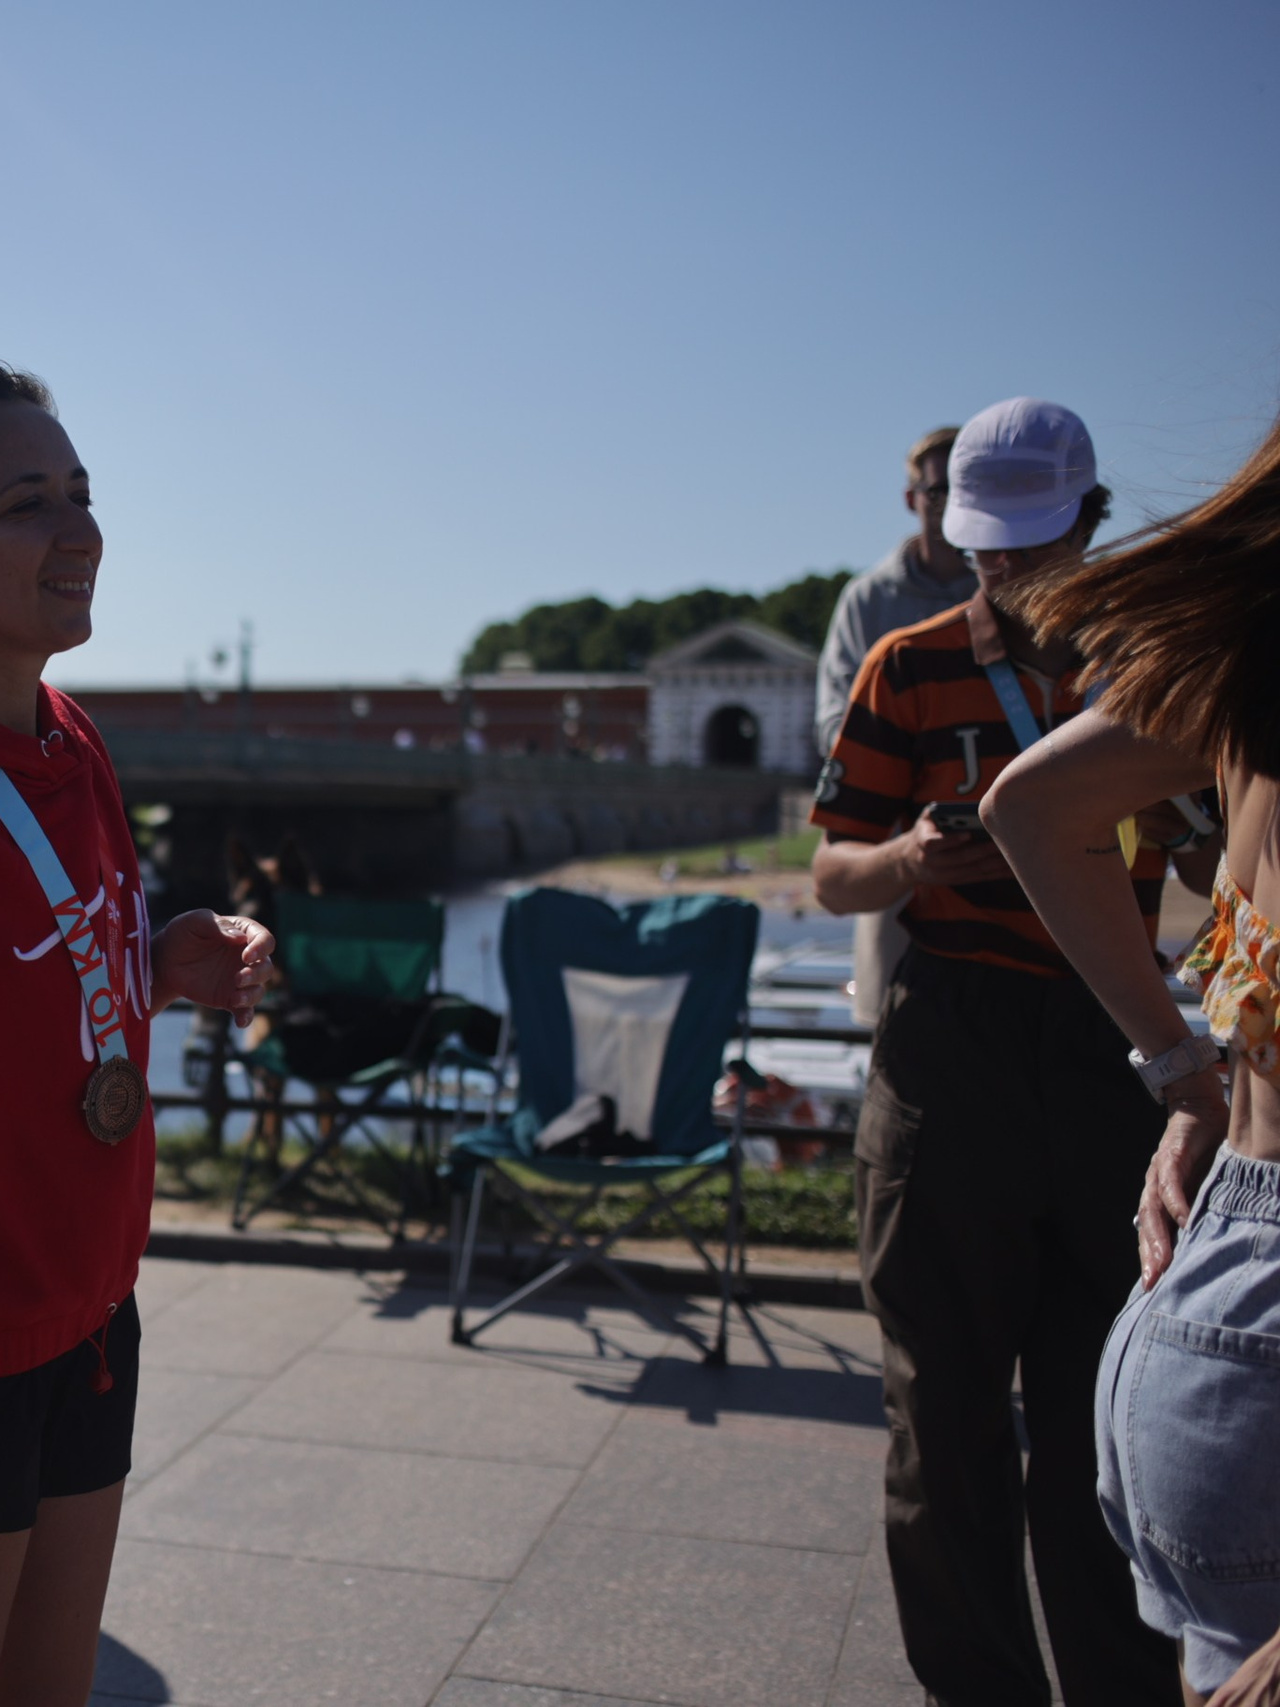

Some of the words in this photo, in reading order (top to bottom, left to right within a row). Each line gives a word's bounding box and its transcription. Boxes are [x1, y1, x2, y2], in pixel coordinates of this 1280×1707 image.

[955, 727, 981, 795] J
[52, 894, 103, 978] KM
[89, 988, 123, 1047] 10
